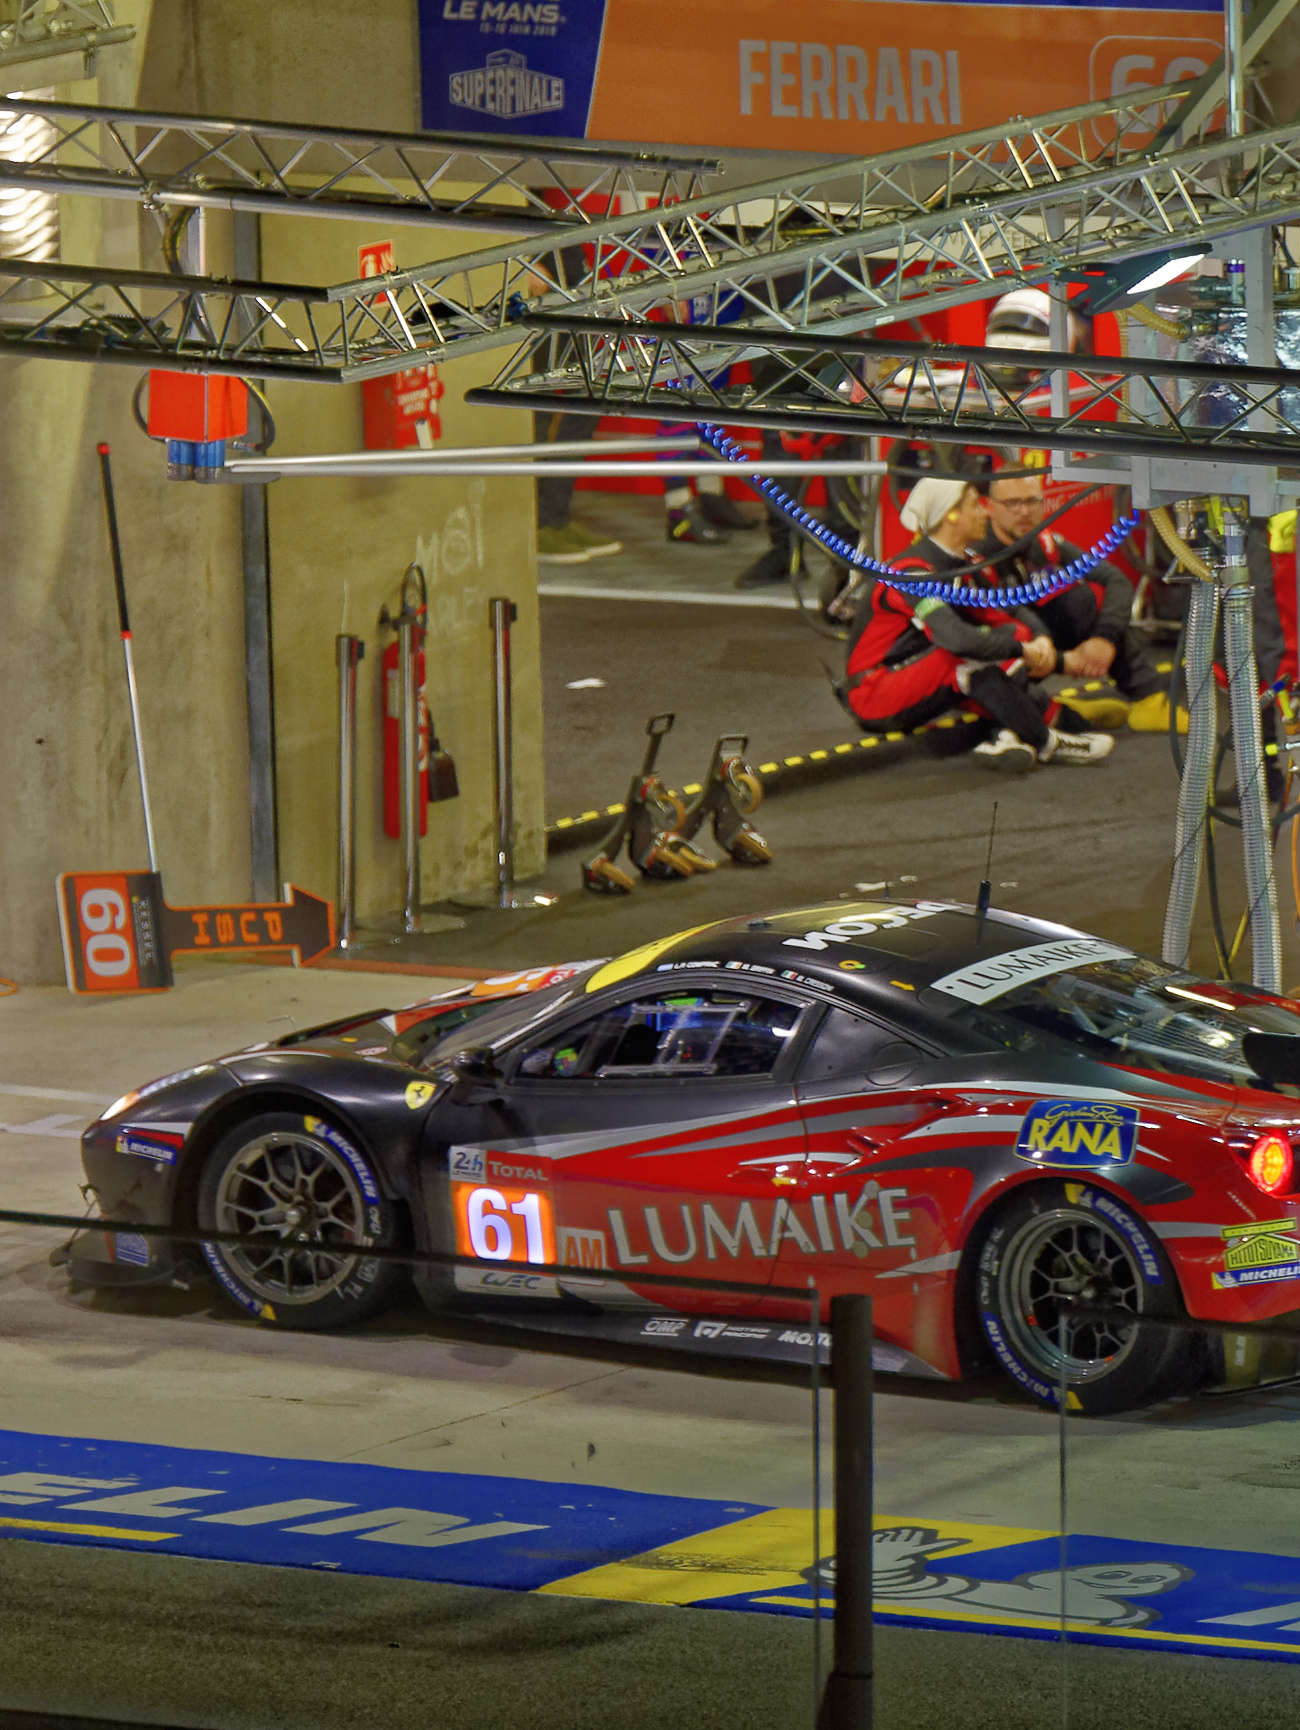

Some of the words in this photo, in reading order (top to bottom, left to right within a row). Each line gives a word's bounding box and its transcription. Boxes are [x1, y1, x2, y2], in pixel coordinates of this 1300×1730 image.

[443, 0, 477, 20] LE
[480, 2, 561, 24] MANS
[451, 69, 562, 114] SUPERFINALE
[739, 39, 962, 126] FERRARI
[79, 887, 131, 978] 60
[191, 910, 283, 946] PUSH
[957, 941, 1102, 990] LUMAIKE
[329, 1126, 377, 1199] MICHELIN
[1027, 1118, 1123, 1159] RANA
[489, 1160, 549, 1182] TOTAL
[468, 1187, 545, 1265] 61
[564, 1236, 603, 1269] AM
[608, 1187, 916, 1266] LUMAIKE
[1095, 1193, 1160, 1279] MICHELIN
[986, 1318, 1050, 1398] MICHELIN
